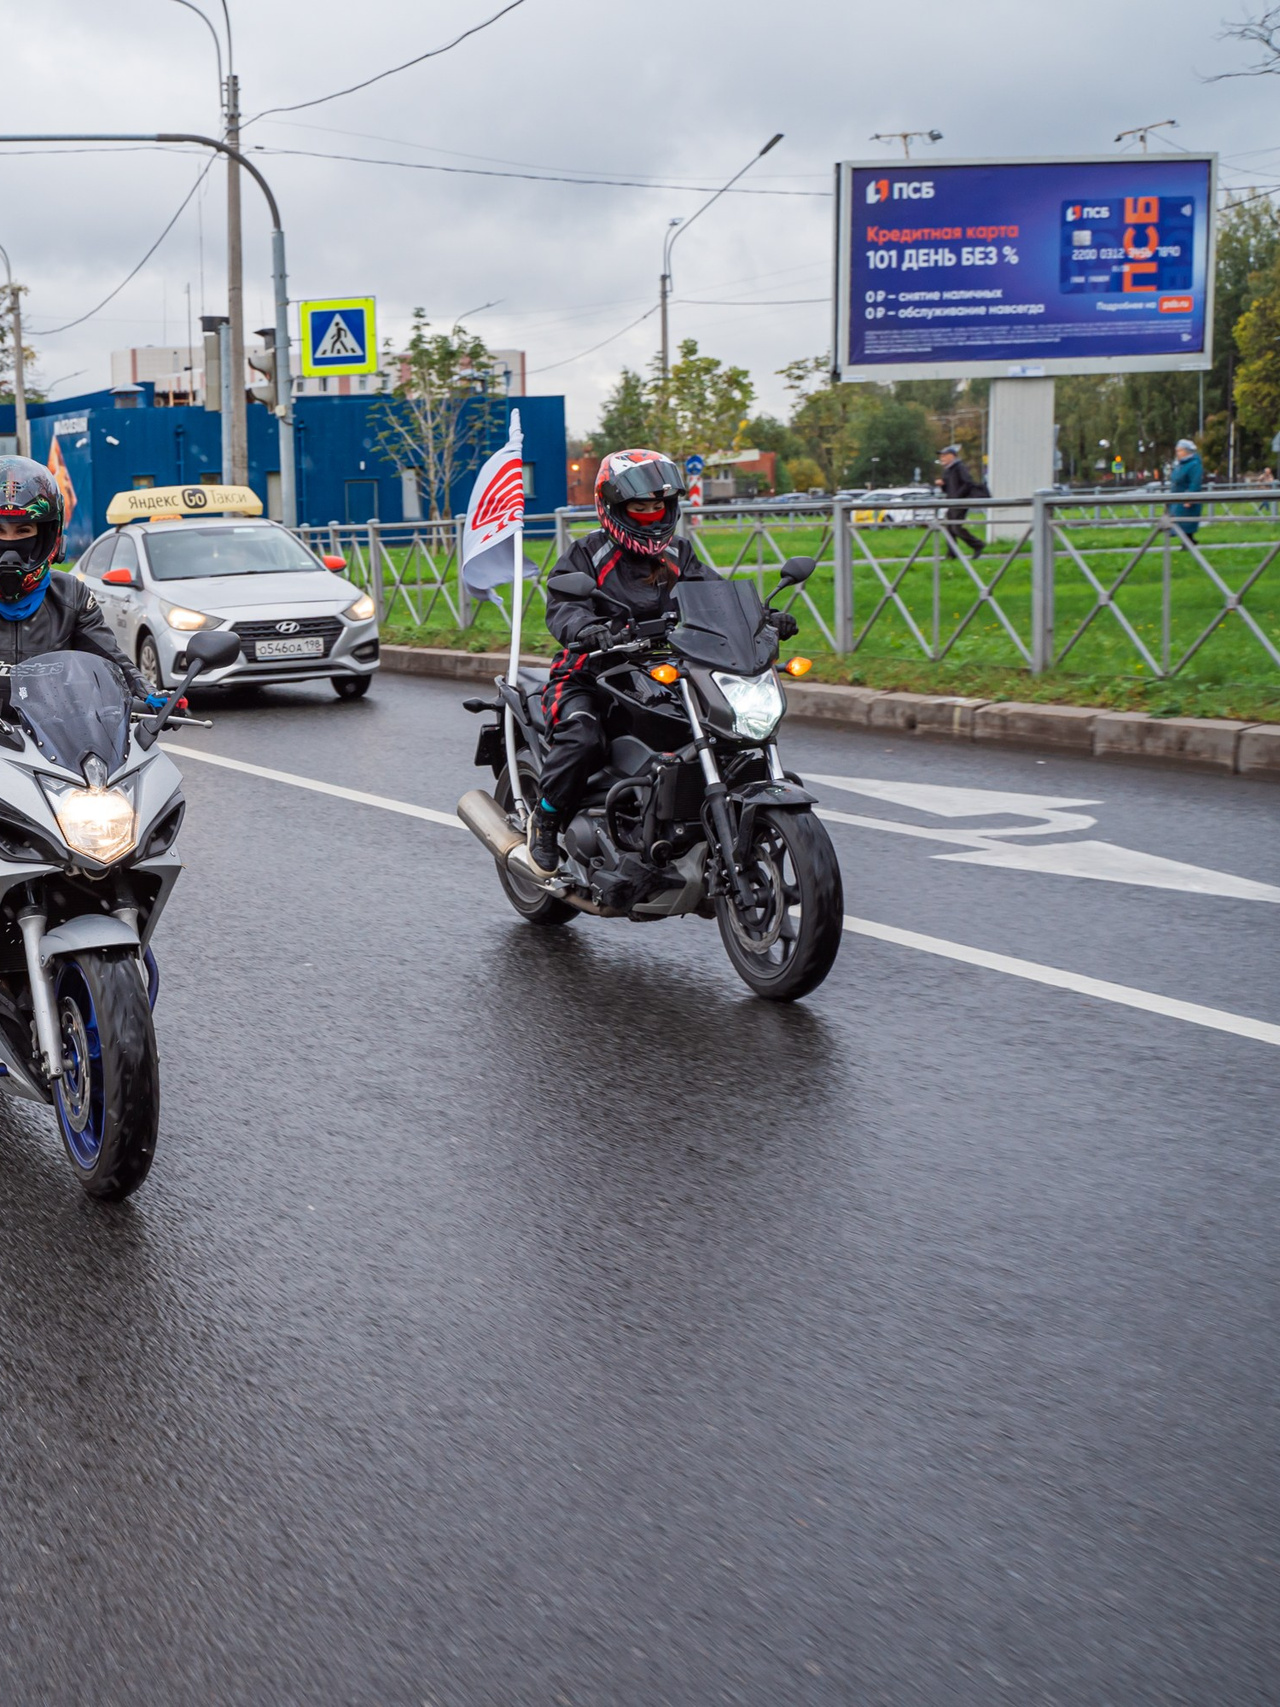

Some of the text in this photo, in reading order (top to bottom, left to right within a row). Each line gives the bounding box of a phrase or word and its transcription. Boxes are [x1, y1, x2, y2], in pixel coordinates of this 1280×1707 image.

[893, 181, 935, 200] ПСБ
[1083, 206, 1110, 219] ПСБ
[866, 225, 1019, 245] Кредитная карта
[1122, 196, 1159, 293] ПСБ
[866, 245, 1019, 271] 101 ДЕНЬ БЕЗ %
[128, 489, 247, 510] Яндекс Go Такси
